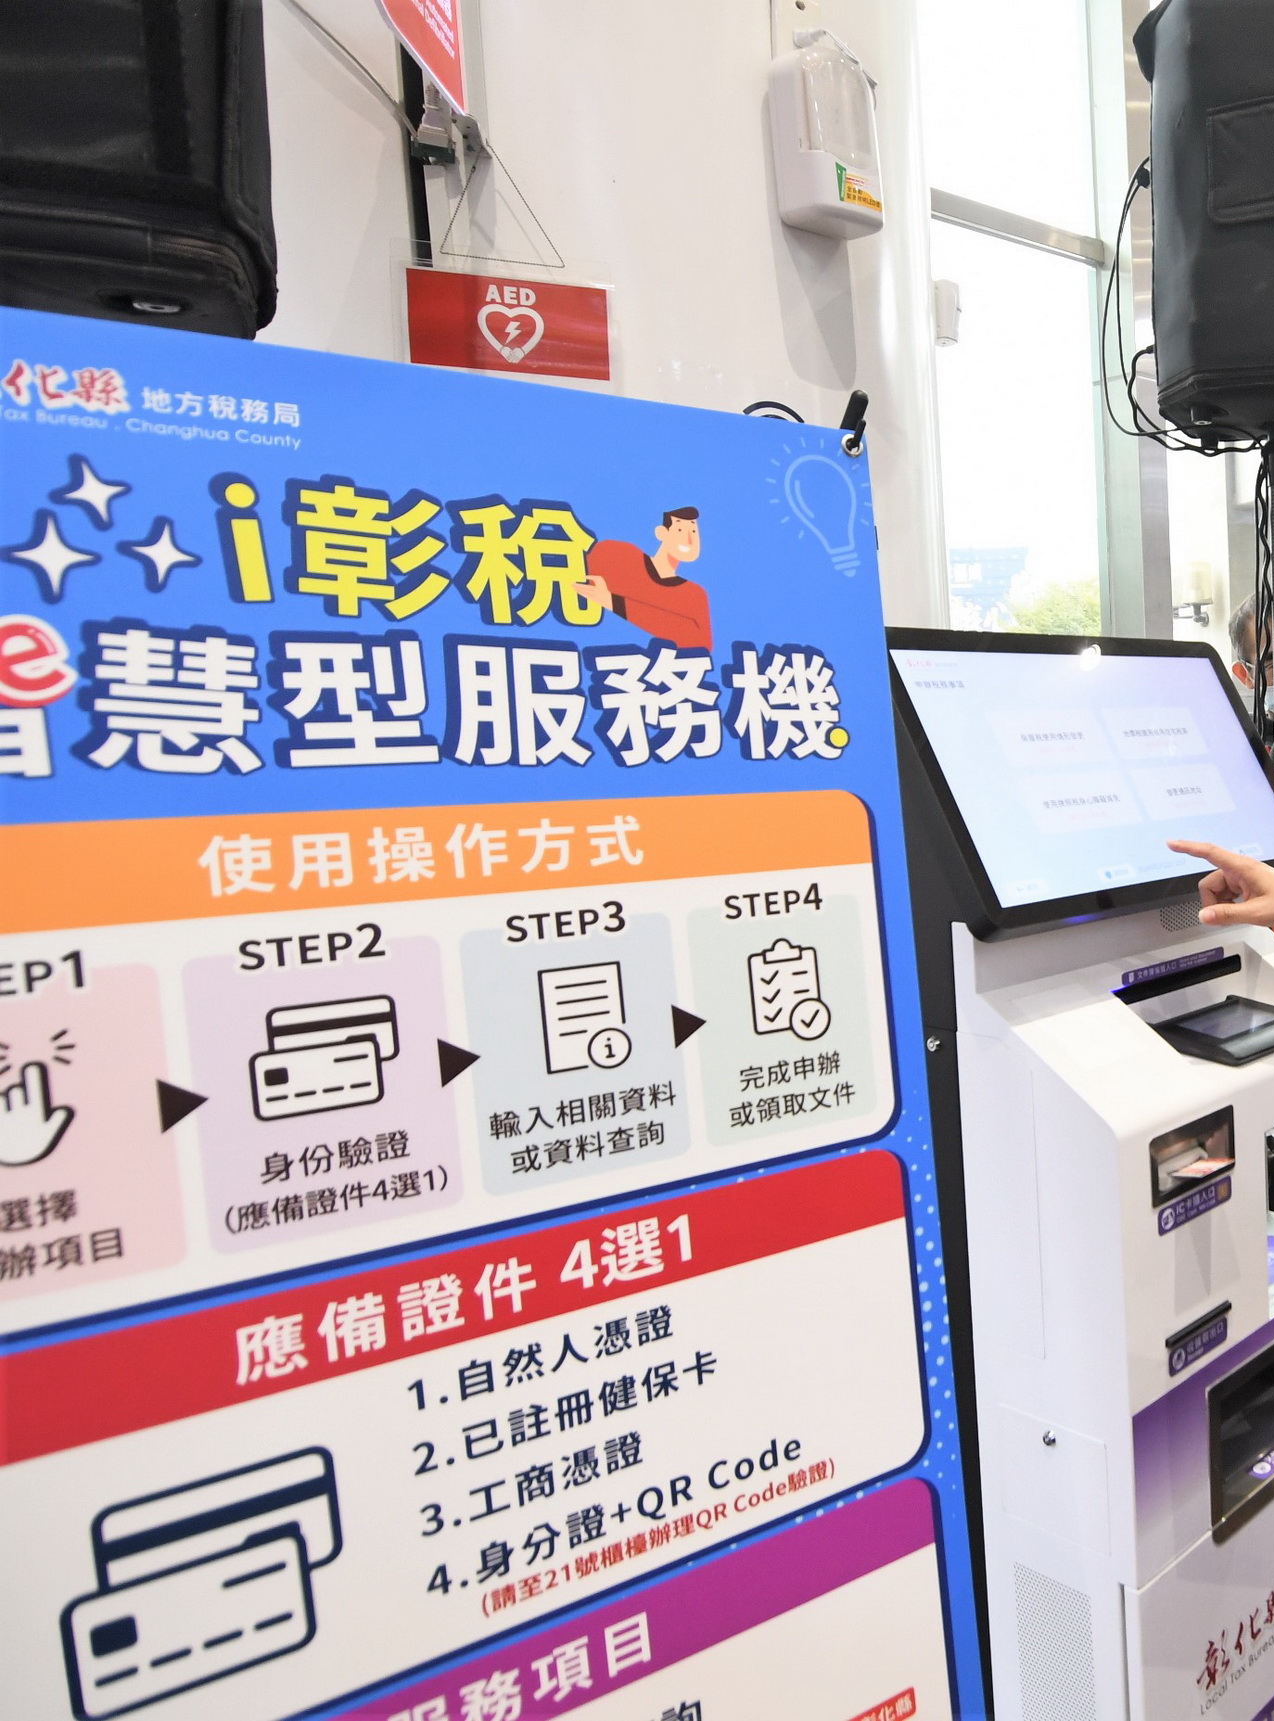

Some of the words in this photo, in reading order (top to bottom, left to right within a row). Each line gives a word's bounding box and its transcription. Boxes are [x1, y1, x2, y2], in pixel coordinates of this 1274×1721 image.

[485, 284, 536, 306] AED
[0, 406, 28, 422] ax
[36, 410, 108, 430] Bureau
[126, 417, 229, 441] Changhua
[235, 428, 301, 451] County
[142, 386, 300, 428] 地方稅務局
[197, 815, 645, 897] 使用操作方式
[506, 901, 626, 943] STEP3
[724, 883, 823, 920] STEP4
[238, 922, 386, 971] STEP2
[739, 1050, 842, 1093] 完成申辦
[489, 1080, 677, 1141] 輸入相關資料
[729, 1081, 856, 1129] 或領取文件
[259, 1129, 411, 1185] 身份驗證
[510, 1121, 666, 1175] 或資料查詢
[225, 1164, 448, 1236] (應備證件4選1)
[235, 1257, 537, 1386] 應備證件
[560, 1214, 693, 1288] 4選1
[709, 1434, 803, 1490] Code
[1200, 1679, 1228, 1715] Local
[1229, 1663, 1247, 1685] Tax
